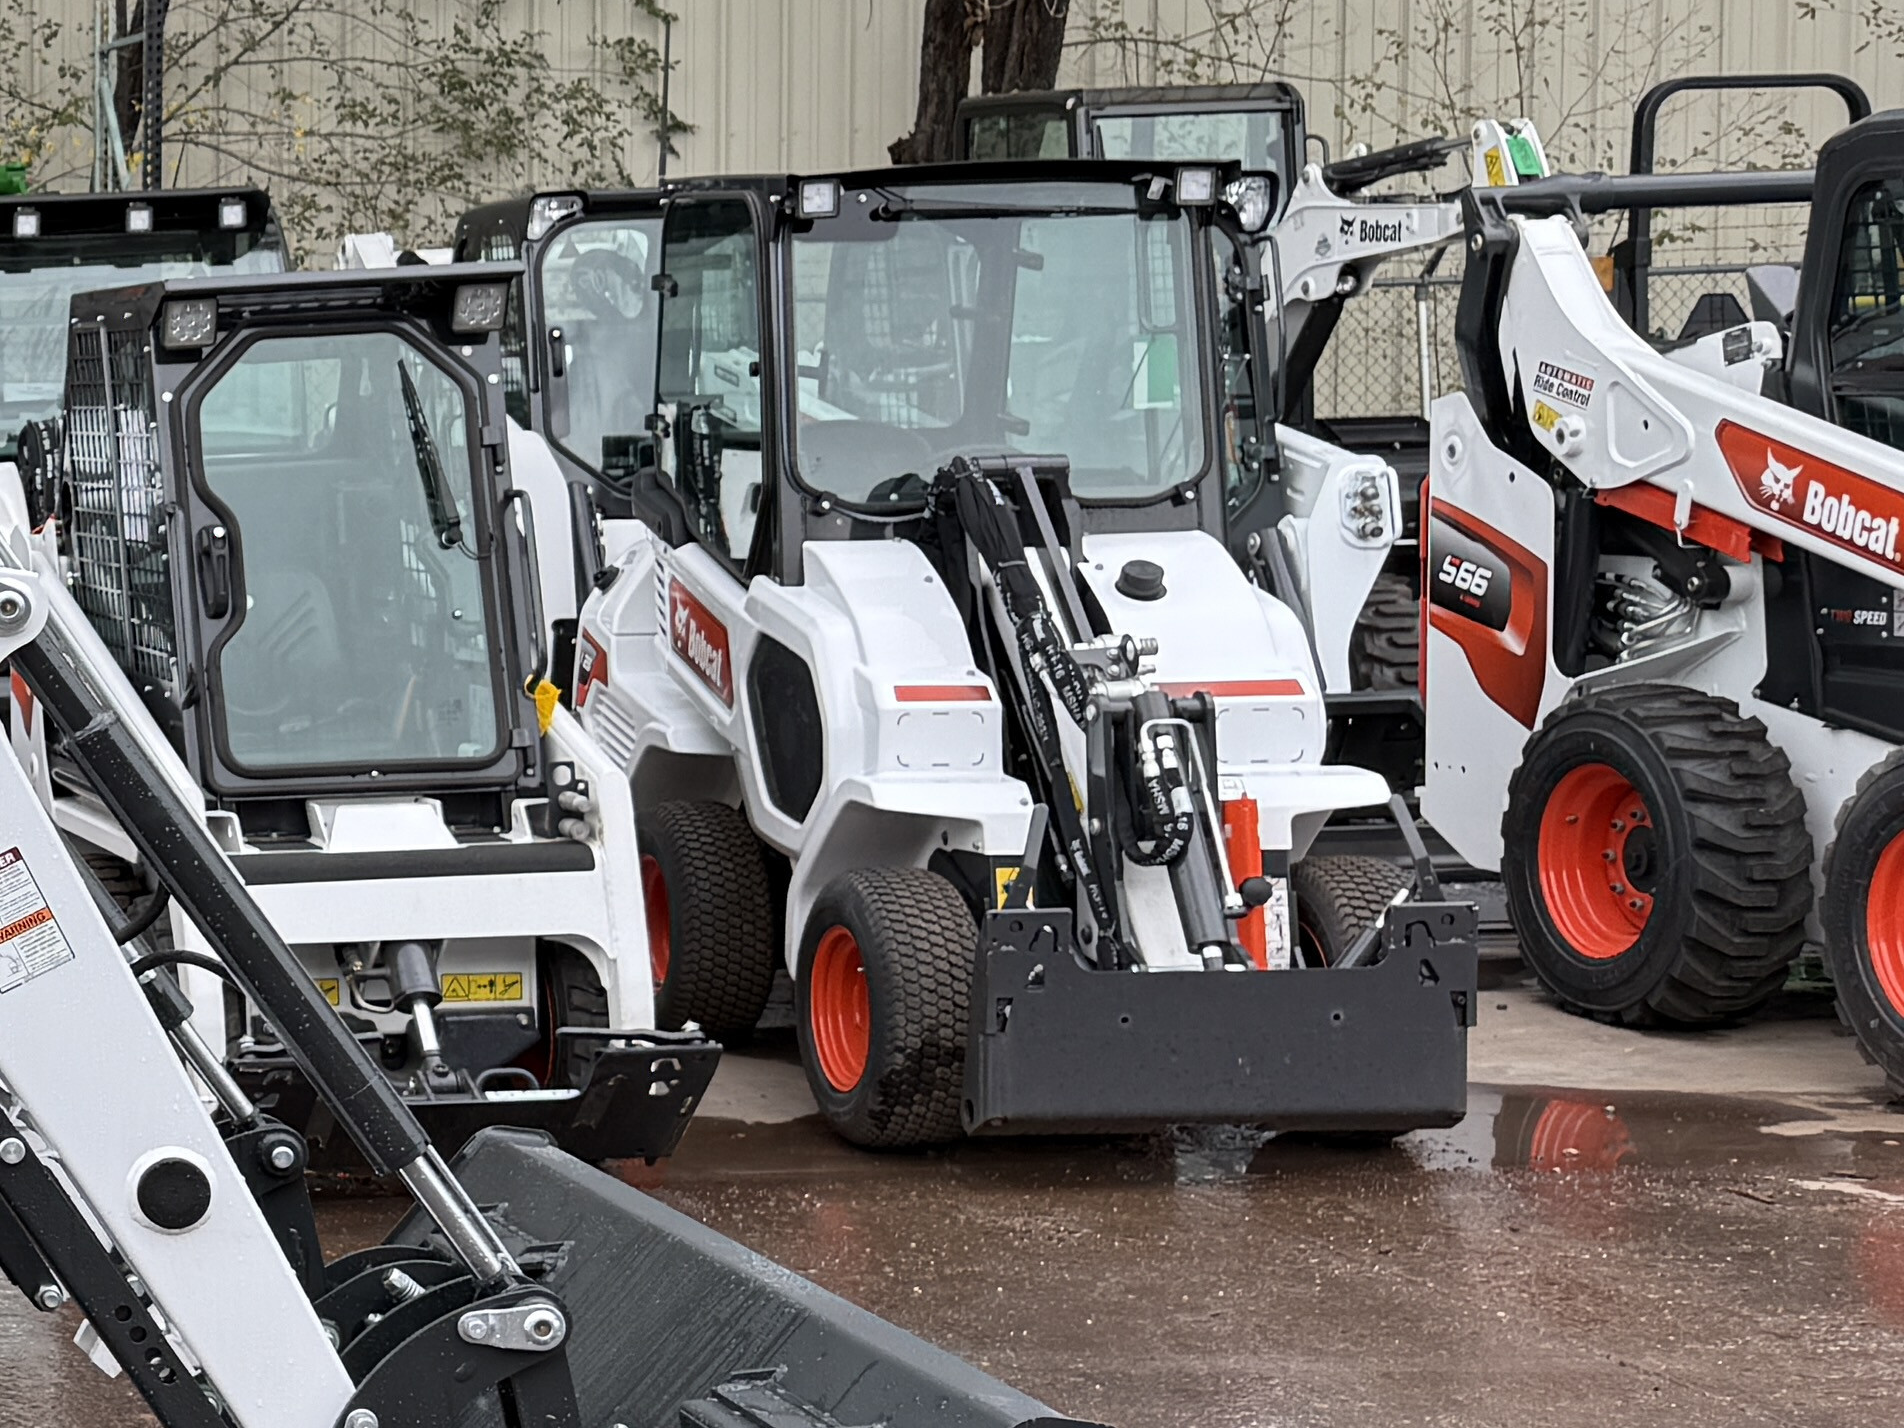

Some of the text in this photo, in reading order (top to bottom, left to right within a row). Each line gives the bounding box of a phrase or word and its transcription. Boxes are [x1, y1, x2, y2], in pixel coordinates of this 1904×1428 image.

[1360, 220, 1402, 244] Bobcat
[1533, 374, 1592, 408] Ride Control
[1540, 361, 1595, 392] AUTOMATIC
[1803, 479, 1900, 561] Bobcat
[1438, 554, 1493, 597] S66
[1852, 609, 1889, 627] SPEED
[686, 617, 723, 688] Bobcat
